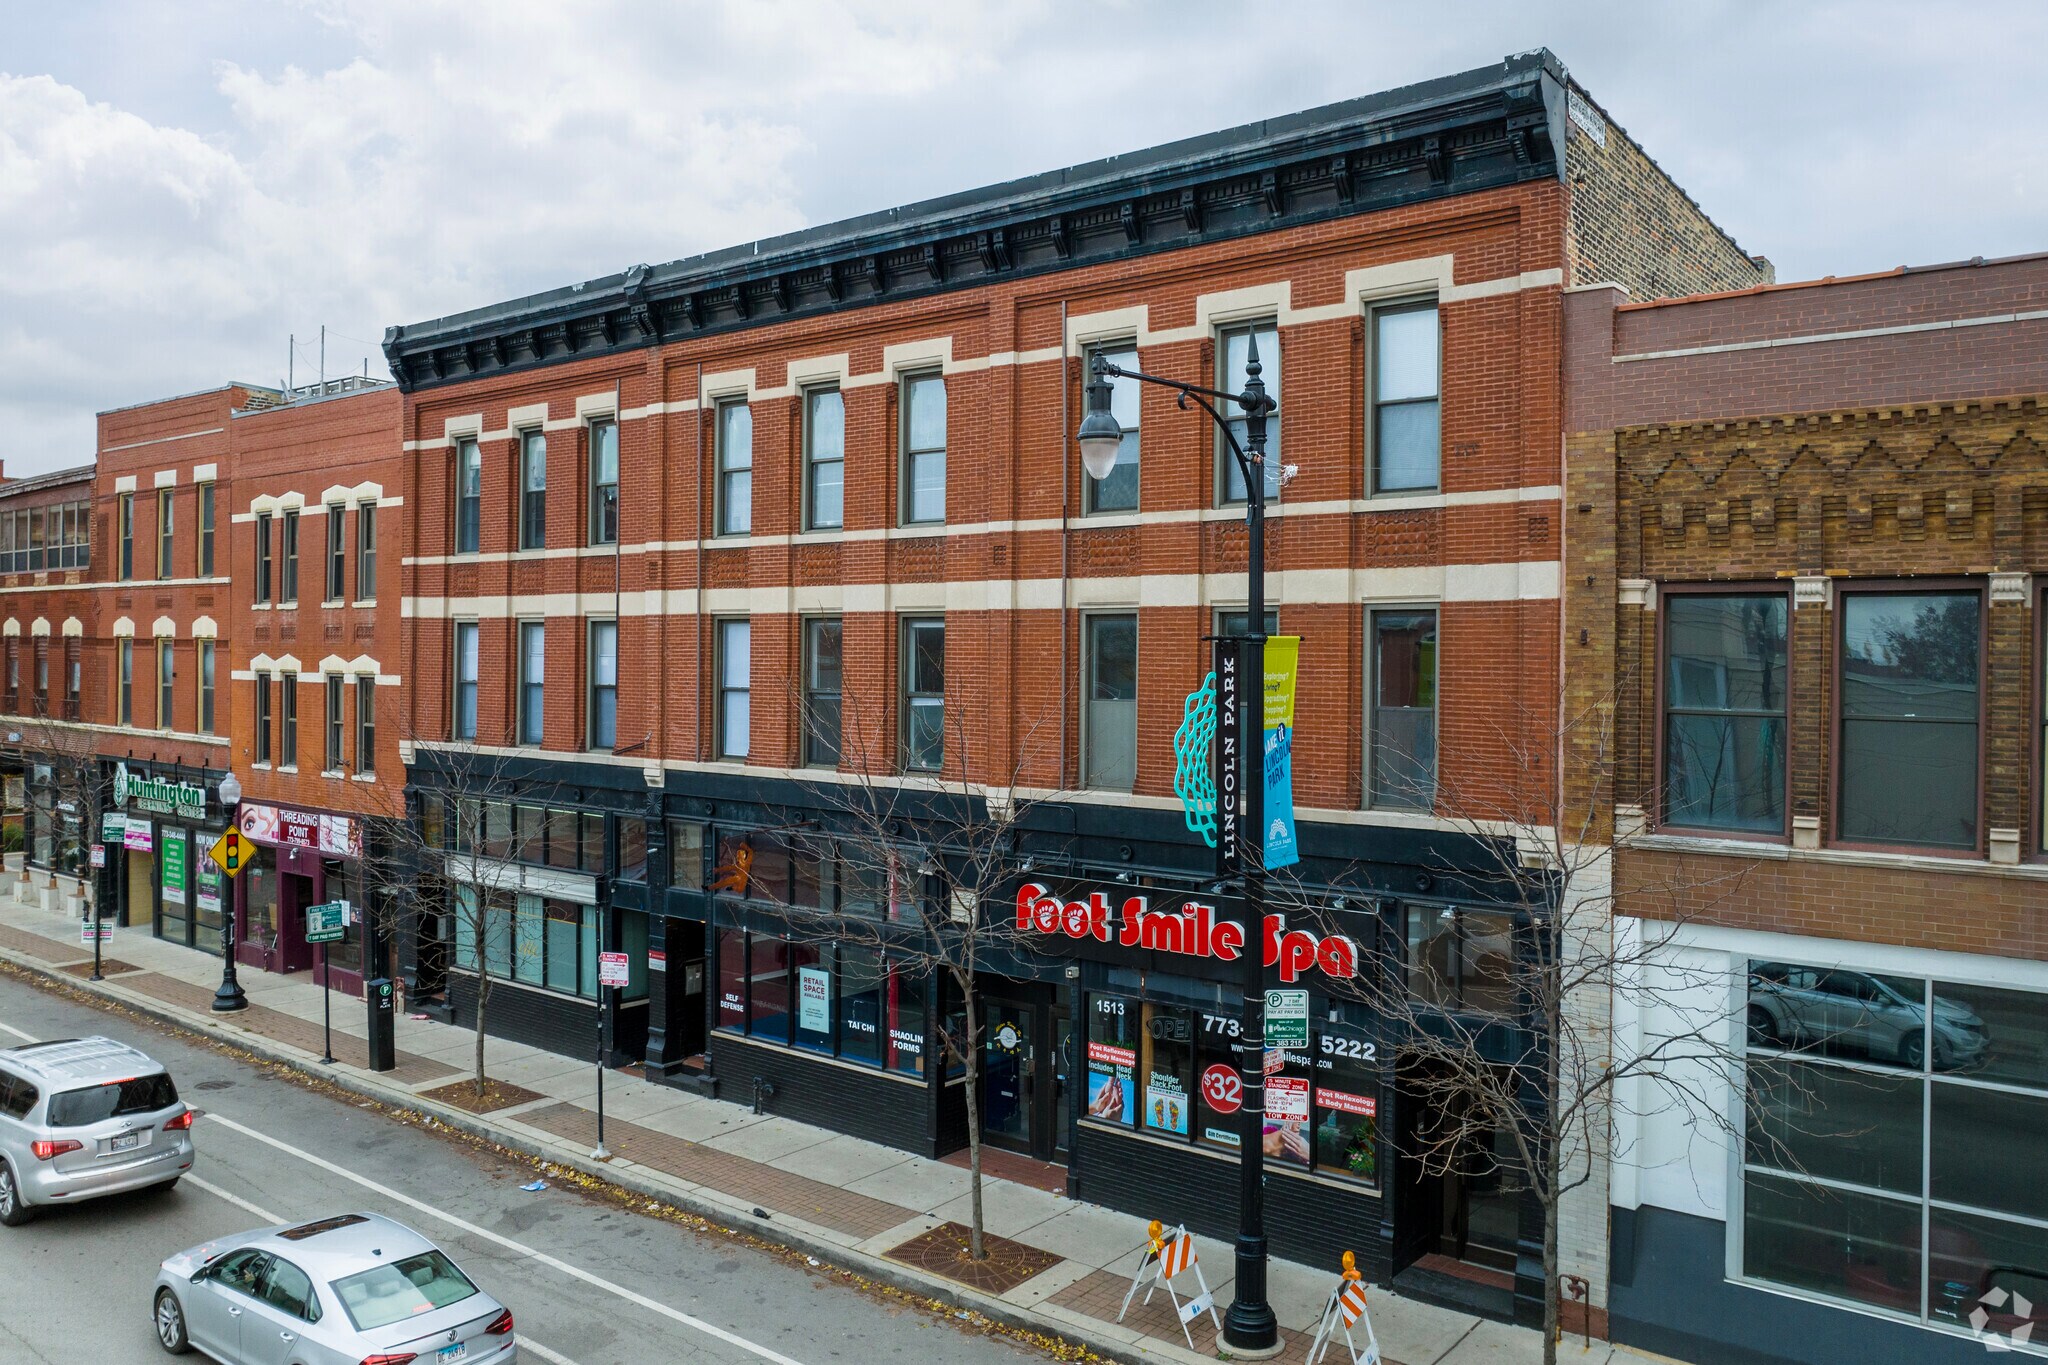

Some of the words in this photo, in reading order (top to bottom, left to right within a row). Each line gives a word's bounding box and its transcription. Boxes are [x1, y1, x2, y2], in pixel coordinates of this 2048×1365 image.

[1224, 657, 1235, 726] PARK
[1264, 715, 1291, 725] elebrating?
[1278, 724, 1285, 742] it
[1265, 738, 1291, 773] LINCOLN
[1267, 763, 1285, 791] PARK
[127, 774, 201, 808] Huntington
[1224, 737, 1235, 859] LINCOLN
[137, 797, 173, 814] LEARNING
[176, 804, 205, 819] CENTER
[280, 811, 318, 827] THREADING
[288, 825, 309, 838] POINT
[1016, 883, 1112, 943] Foot
[1119, 895, 1245, 961] Smile
[1263, 913, 1359, 984] Spa
[803, 976, 825, 987] RETAIL
[803, 984, 825, 995] SPACE
[804, 993, 825, 1001] AVAILABLE
[725, 993, 739, 1003] SELF
[720, 1001, 744, 1013] DEFENSE
[1096, 999, 1125, 1015] 1513
[848, 1020, 861, 1031] TAI
[861, 1022, 875, 1033] CHI
[1273, 1024, 1305, 1033] ParkChicago
[889, 1029, 924, 1044] SHAOLIN
[892, 1040, 920, 1054] FORMS
[1089, 1043, 1103, 1051] Foot
[1103, 1046, 1136, 1059] Reflexology
[1321, 1035, 1376, 1062] 5222
[1095, 1051, 1110, 1061] Body
[1110, 1055, 1136, 1066] Massage
[1088, 1060, 1114, 1074] Includes
[1116, 1063, 1132, 1074] Head
[1150, 1070, 1180, 1085] Shoulder
[1204, 1072, 1241, 1104] $32
[1267, 1082, 1290, 1090] STANDING
[1317, 1089, 1334, 1099] Foot
[1334, 1092, 1376, 1107] Reflexology
[1325, 1098, 1342, 1109] Body
[1343, 1102, 1376, 1115] Massage
[1285, 1113, 1305, 1121] ZONE
